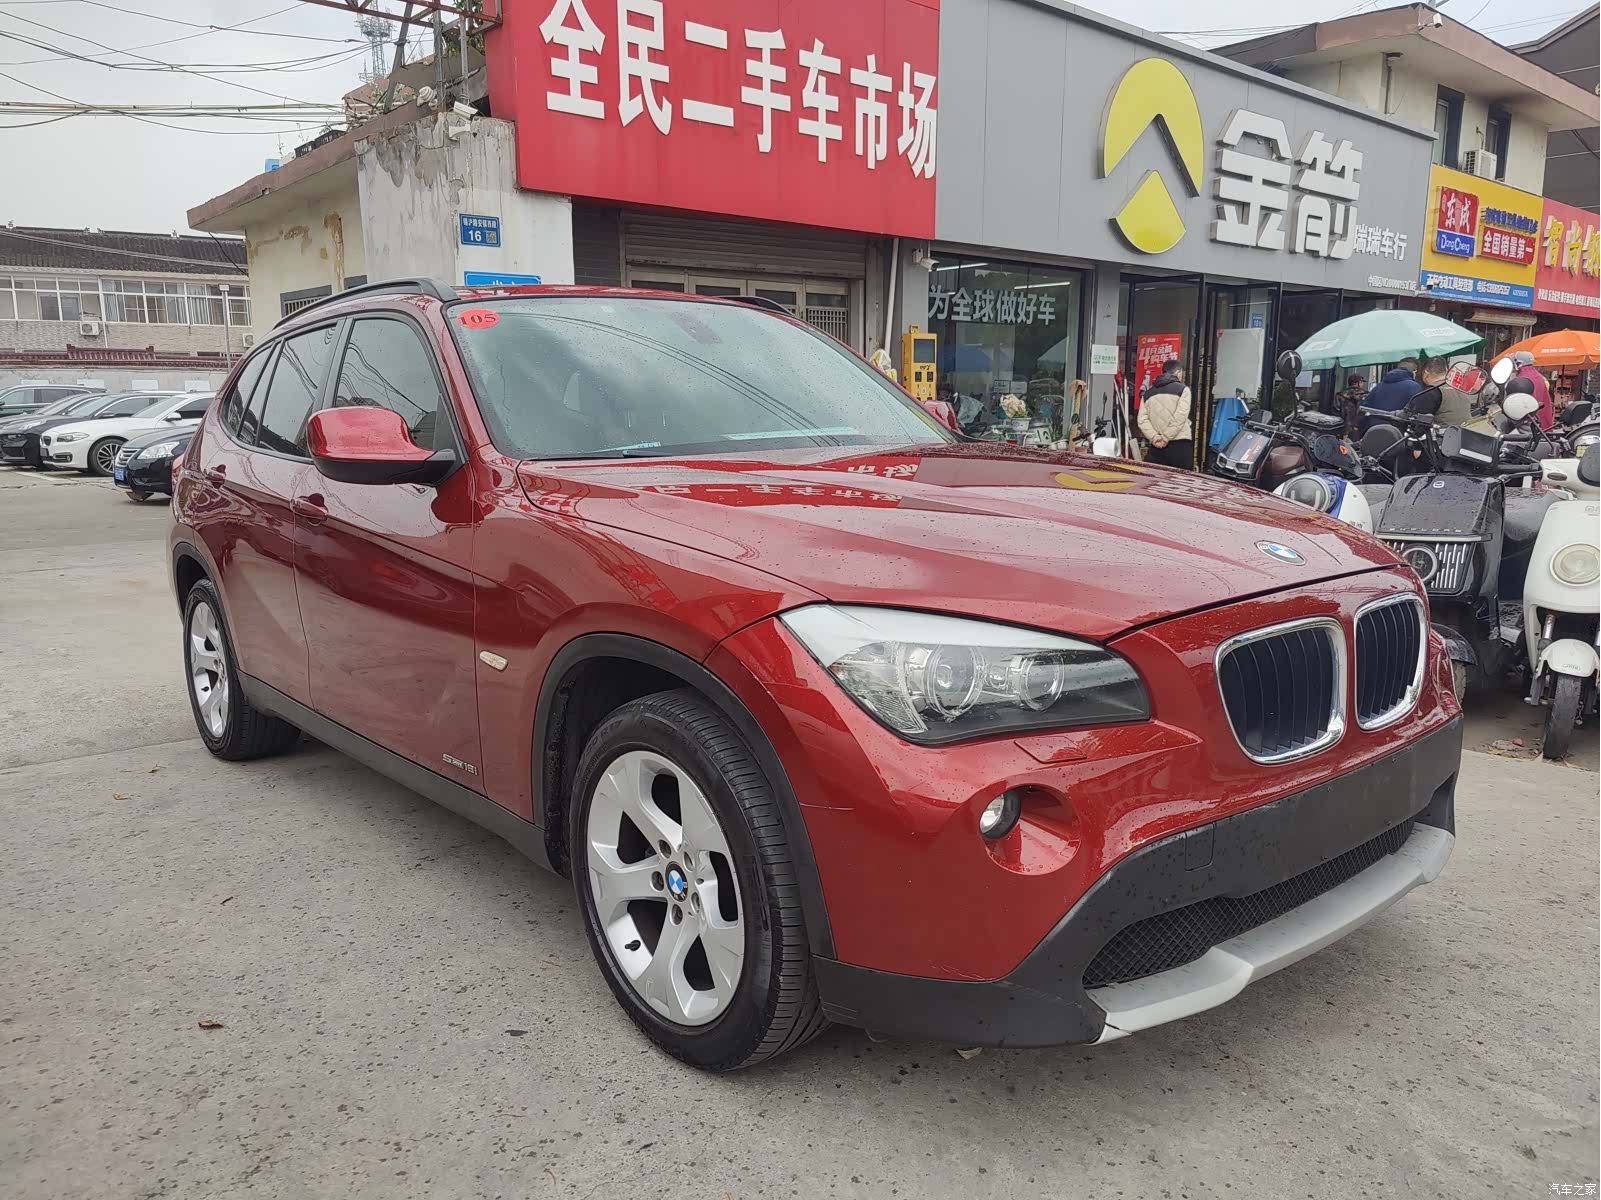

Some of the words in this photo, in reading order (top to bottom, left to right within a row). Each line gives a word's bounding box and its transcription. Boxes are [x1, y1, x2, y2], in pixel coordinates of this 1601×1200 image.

[539, 0, 938, 180] 全民二手车市场
[1212, 108, 1364, 260] 金箭
[468, 229, 482, 242] 16
[1441, 234, 1470, 253] DongCheng
[1483, 230, 1534, 260] 全国销量第一
[457, 313, 497, 325] 105
[928, 284, 1057, 326] 为全球做好车
